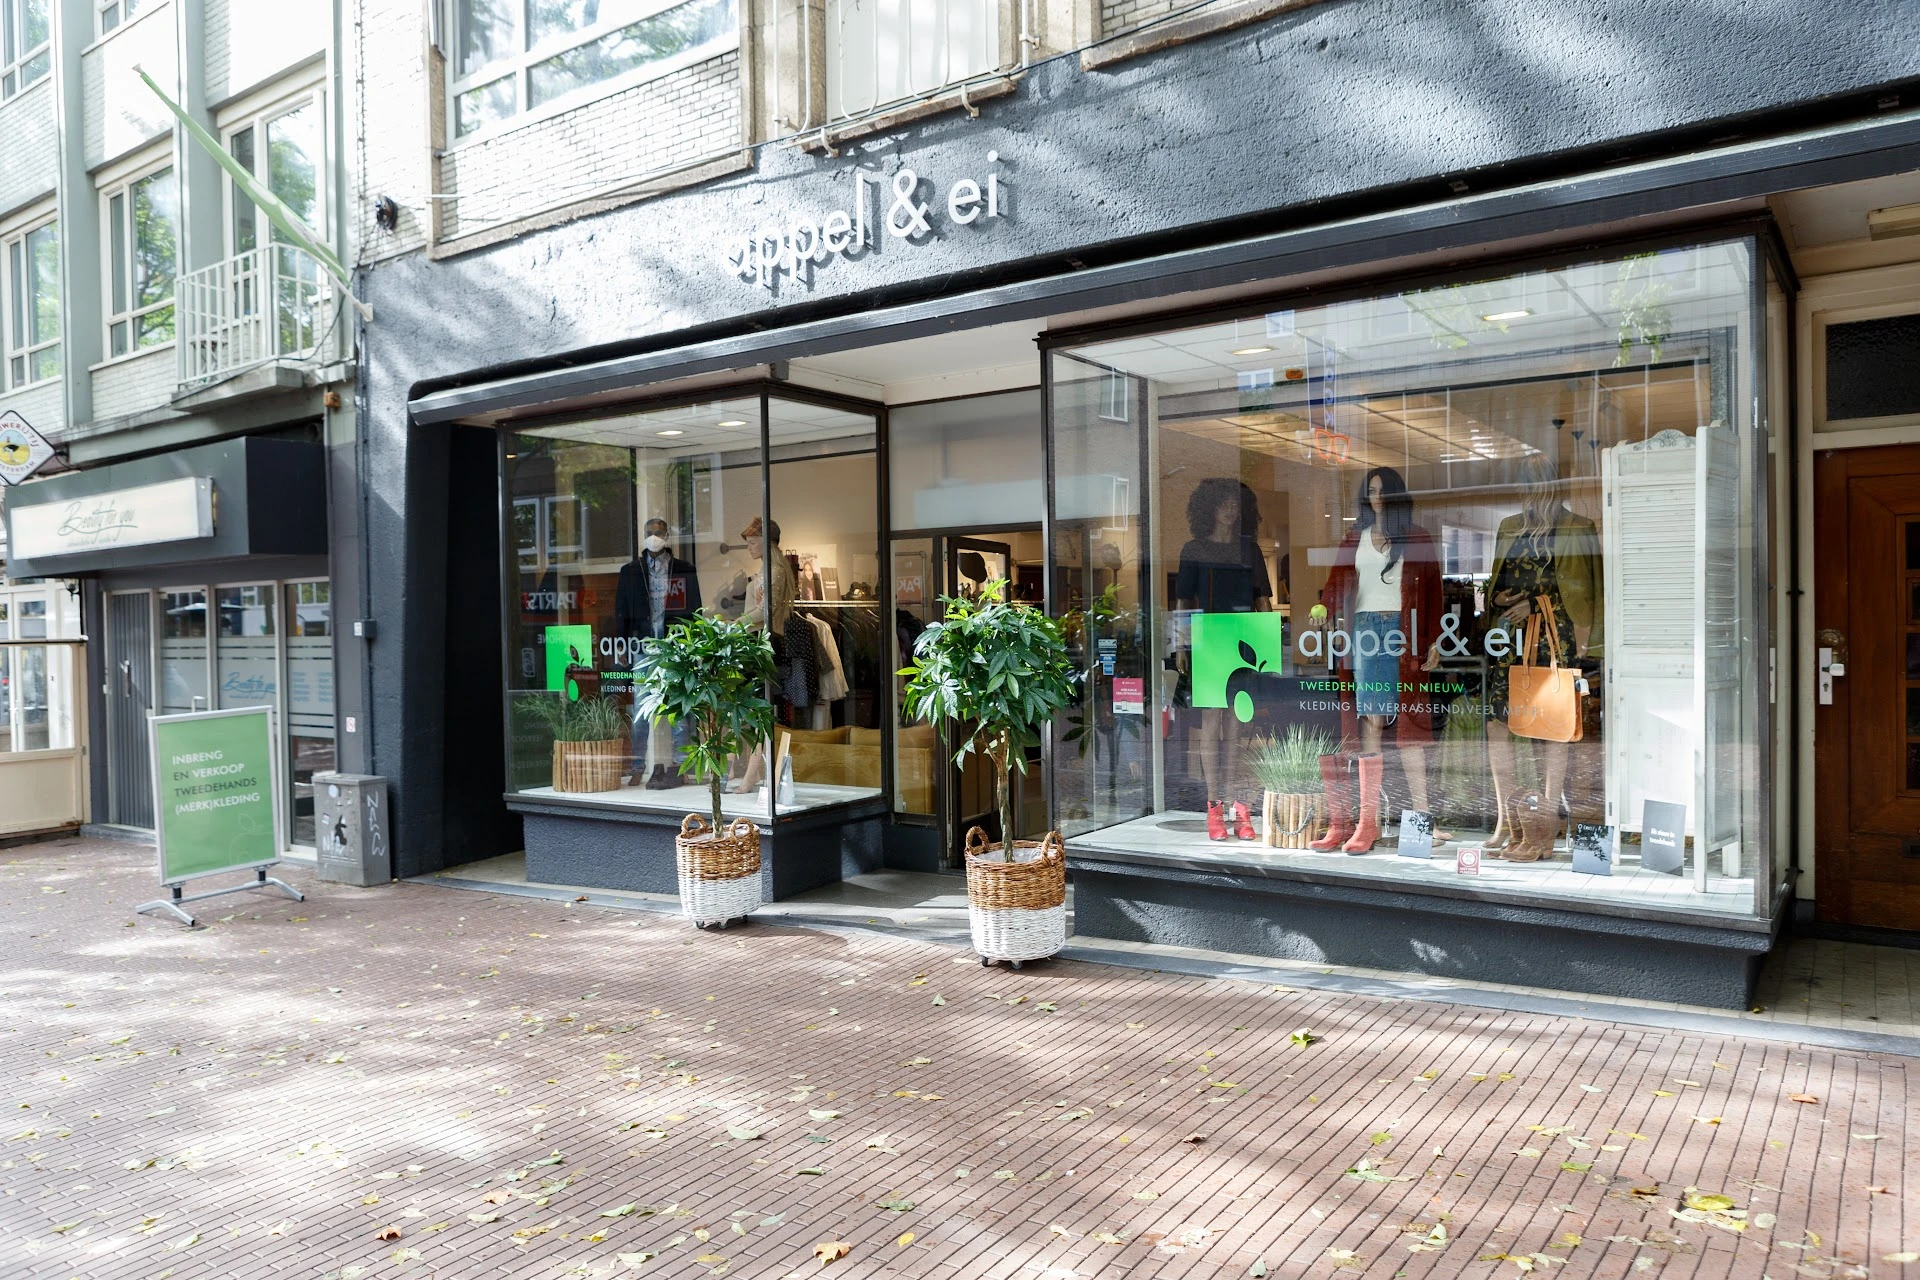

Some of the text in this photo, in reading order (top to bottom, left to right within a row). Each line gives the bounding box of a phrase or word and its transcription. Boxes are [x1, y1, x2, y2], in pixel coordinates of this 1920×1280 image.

[722, 150, 998, 288] appel & ei
[0, 461, 35, 472] STERDAM
[1298, 608, 1523, 670] appel & ei
[600, 636, 657, 664] appe
[600, 671, 646, 679] TWEEDEHANDS
[600, 685, 637, 693] KLEDING EN
[1300, 681, 1465, 693] TWEEDEHANDS EN NIEUW
[1300, 701, 1351, 711] KLEDING
[1356, 702, 1373, 712] EN
[1466, 704, 1497, 715] VEEL
[172, 750, 223, 765] INBRENG
[173, 763, 245, 781] EN VERKOOP
[174, 777, 257, 797] TWEEDEHANDS
[175, 792, 260, 816] (MERK)KLEDING
